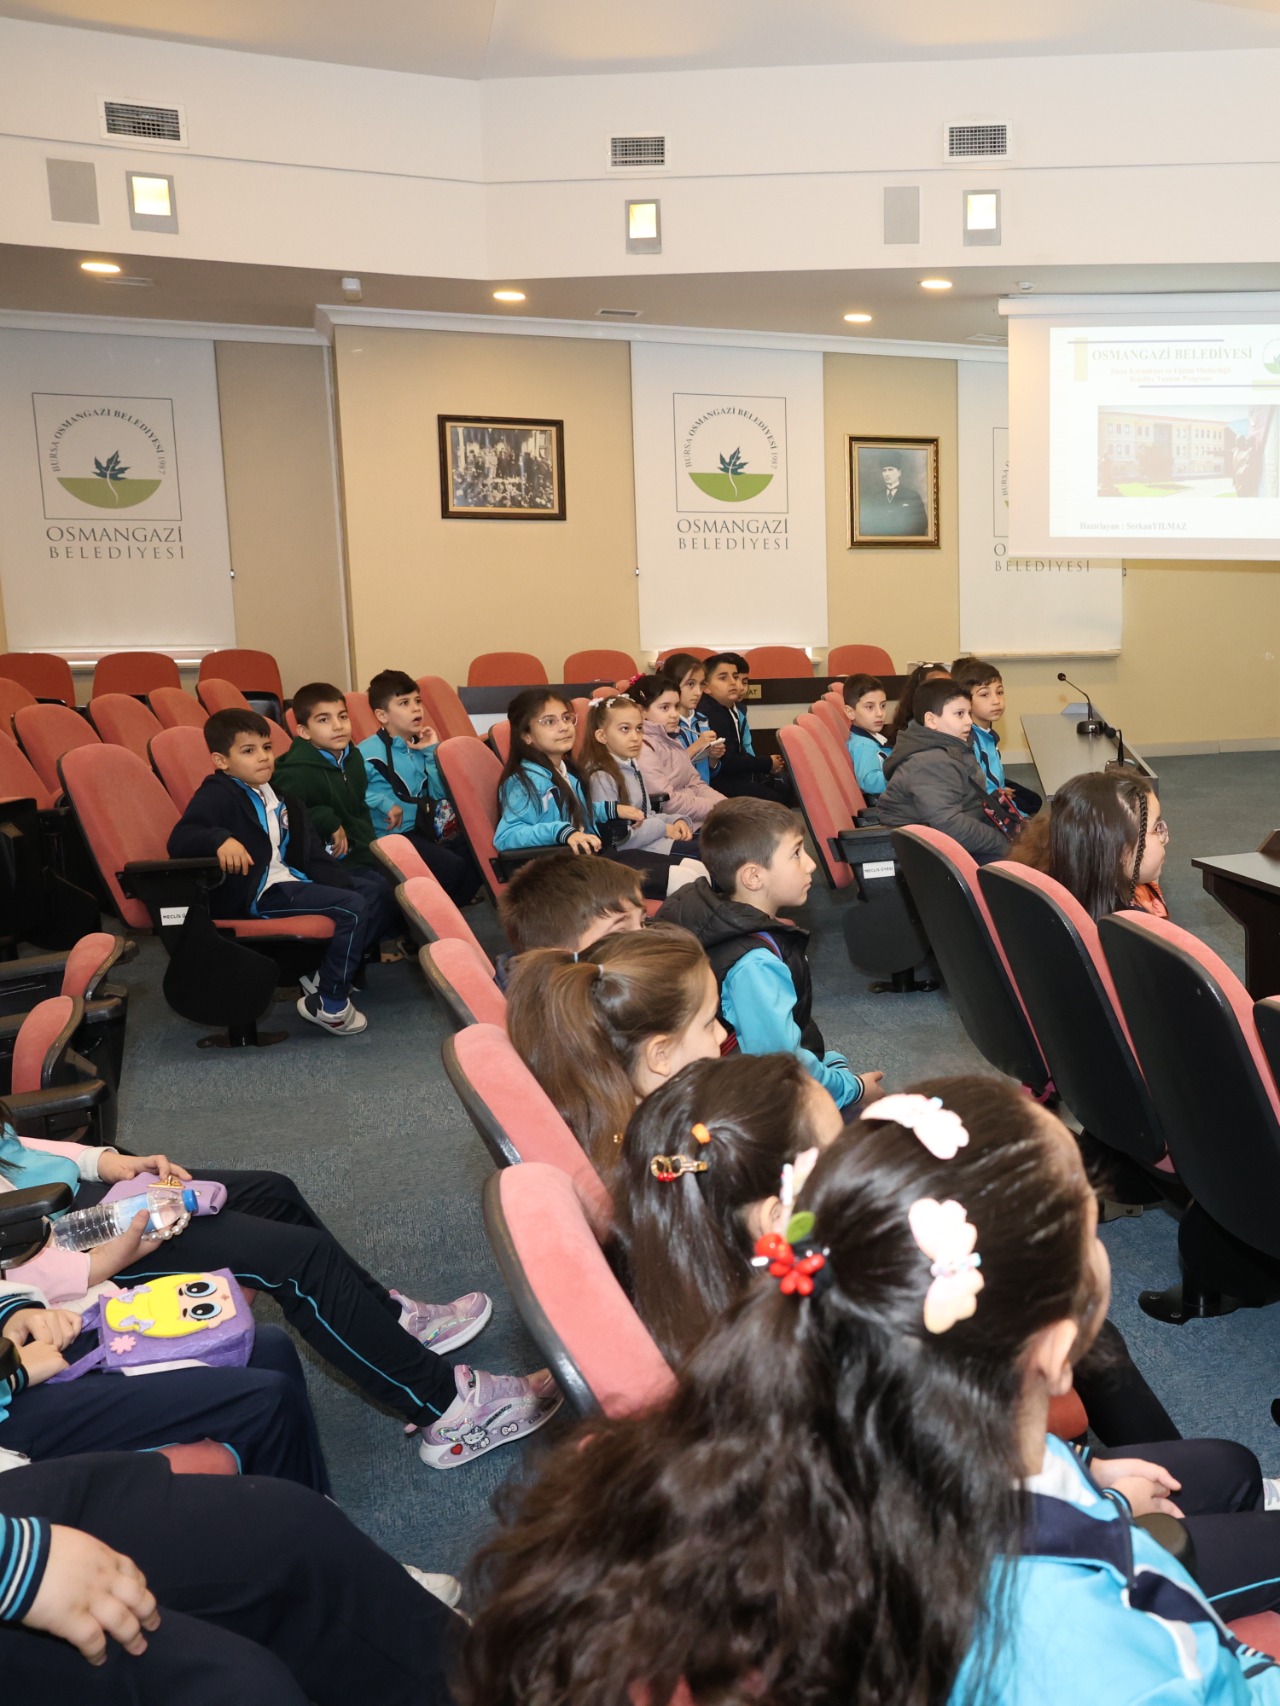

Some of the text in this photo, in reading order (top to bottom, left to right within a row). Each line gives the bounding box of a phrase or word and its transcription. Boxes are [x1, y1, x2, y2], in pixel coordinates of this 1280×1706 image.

[1092, 346, 1170, 360] OSMANGAZİ
[1175, 345, 1253, 359] BELEDİYESİ
[688, 406, 736, 436] OSMANGAZİ
[738, 408, 778, 449] BELEDİYESİ
[49, 441, 60, 472] BURSA
[158, 456, 166, 474] 1987
[684, 438, 693, 468] BURSA
[677, 518, 788, 533] OSMANGAZİ
[46, 525, 184, 543] OSMANGAZİ
[679, 537, 788, 550] BELEDİYESİ
[49, 545, 185, 559] BELEDİYESİ
[995, 559, 1090, 572] BELEDİYESİ
